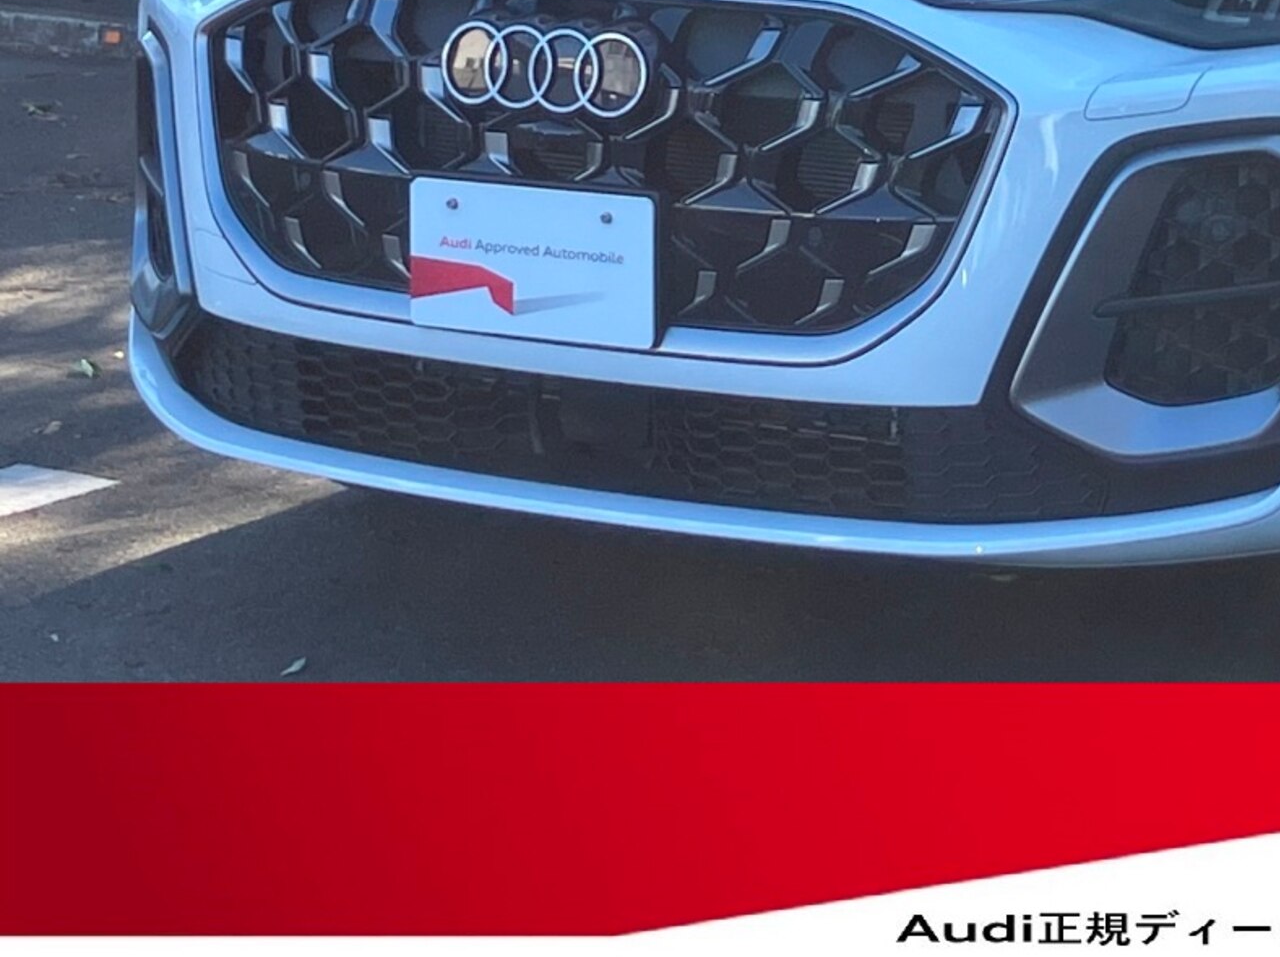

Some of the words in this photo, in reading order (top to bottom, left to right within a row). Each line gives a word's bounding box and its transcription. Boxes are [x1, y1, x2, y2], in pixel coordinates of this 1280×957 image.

[439, 235, 473, 250] Audi
[474, 238, 540, 257] Approved
[542, 244, 625, 265] Automobile
